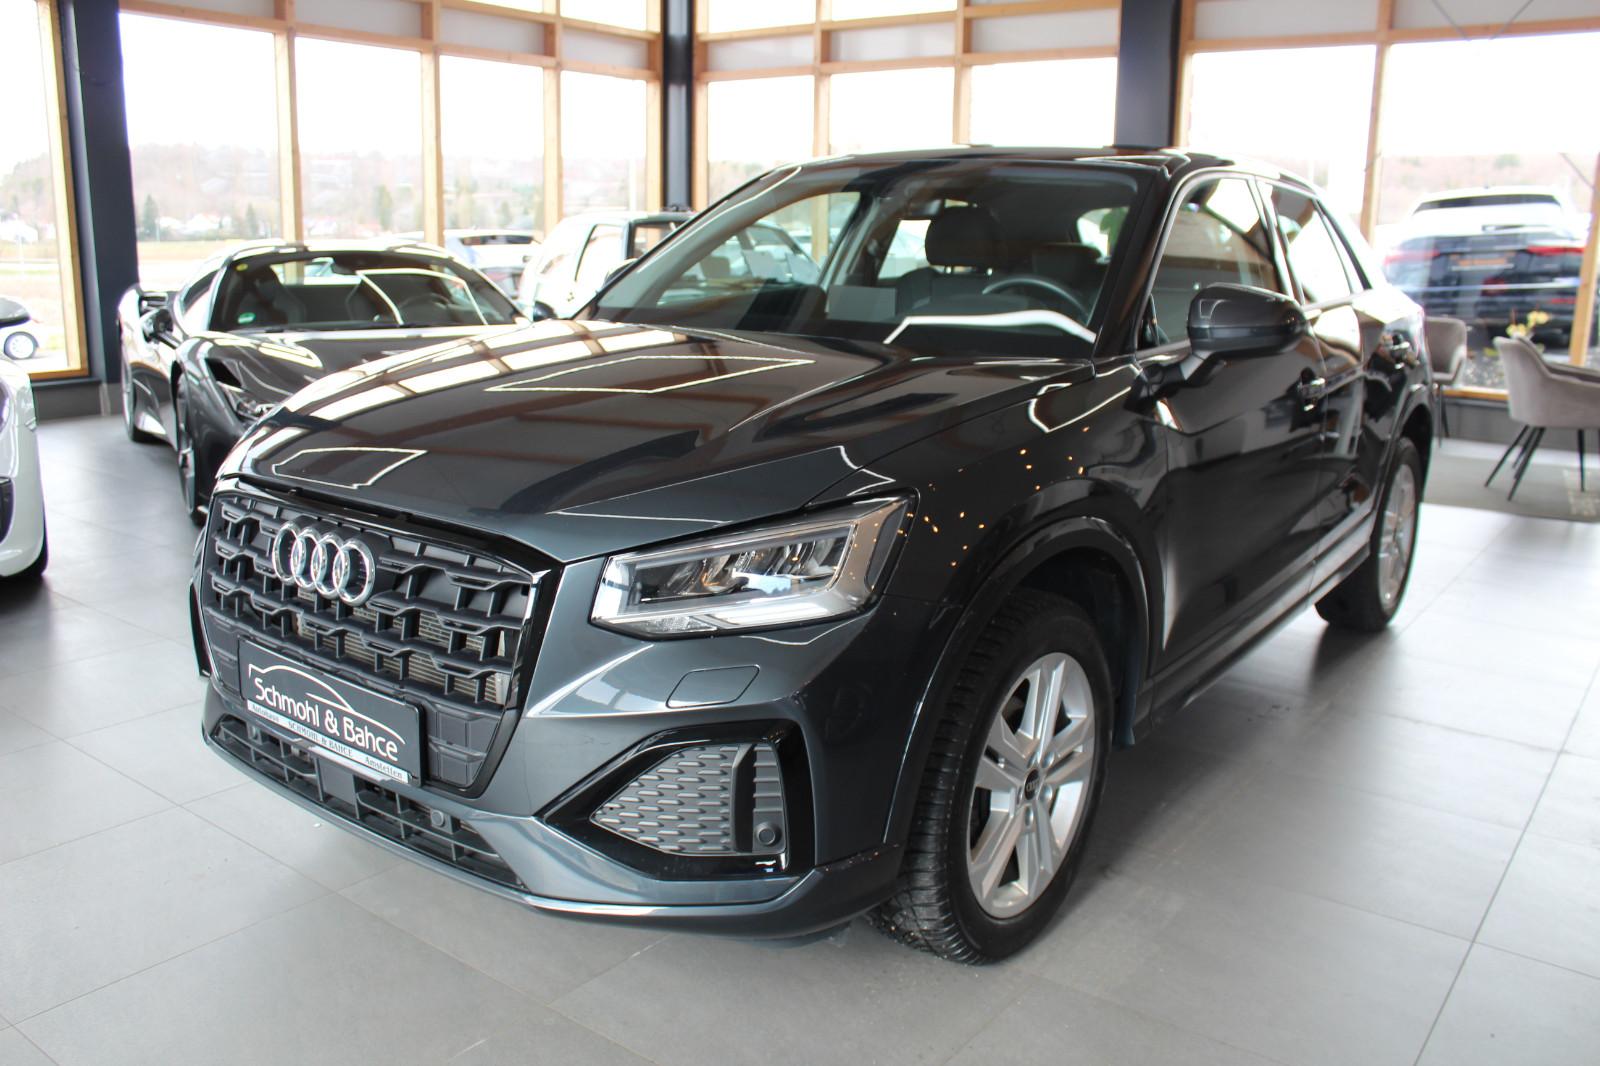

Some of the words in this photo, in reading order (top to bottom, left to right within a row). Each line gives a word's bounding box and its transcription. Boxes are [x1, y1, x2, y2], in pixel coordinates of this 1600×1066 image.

[254, 677, 320, 727] Schmohl
[324, 709, 340, 737] &
[343, 716, 398, 762] Bahce
[288, 721, 319, 741] SCHMOHL
[329, 741, 353, 757] BAHCE
[365, 756, 403, 779] Amstetten
